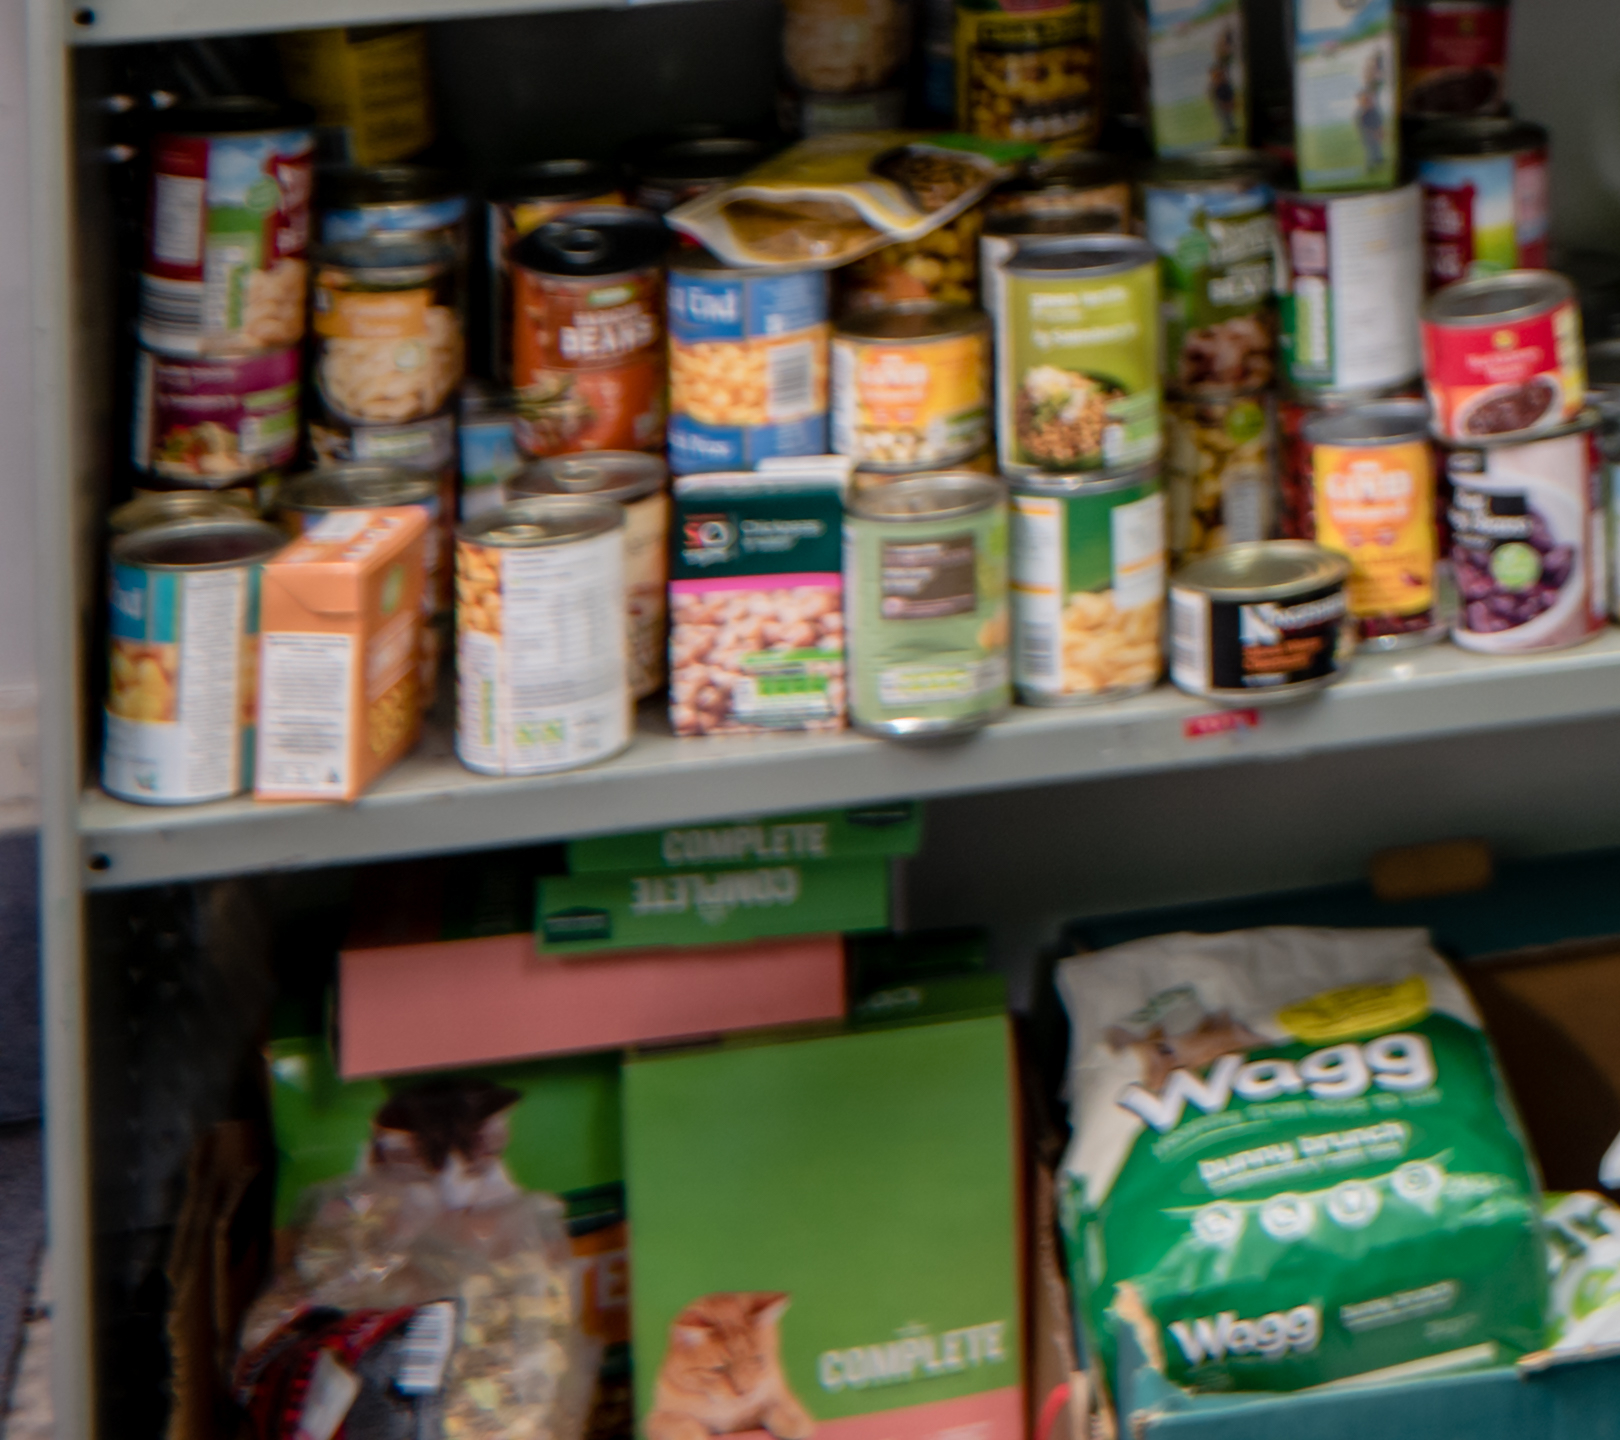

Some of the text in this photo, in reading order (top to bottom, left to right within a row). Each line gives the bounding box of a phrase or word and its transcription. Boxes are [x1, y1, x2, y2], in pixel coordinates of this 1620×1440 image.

[661, 823, 827, 863] COMPLETE
[1118, 1033, 1436, 1133] Wagg
[817, 1323, 1005, 1392] COMPLETE
[1169, 1306, 1322, 1364] Wagg
